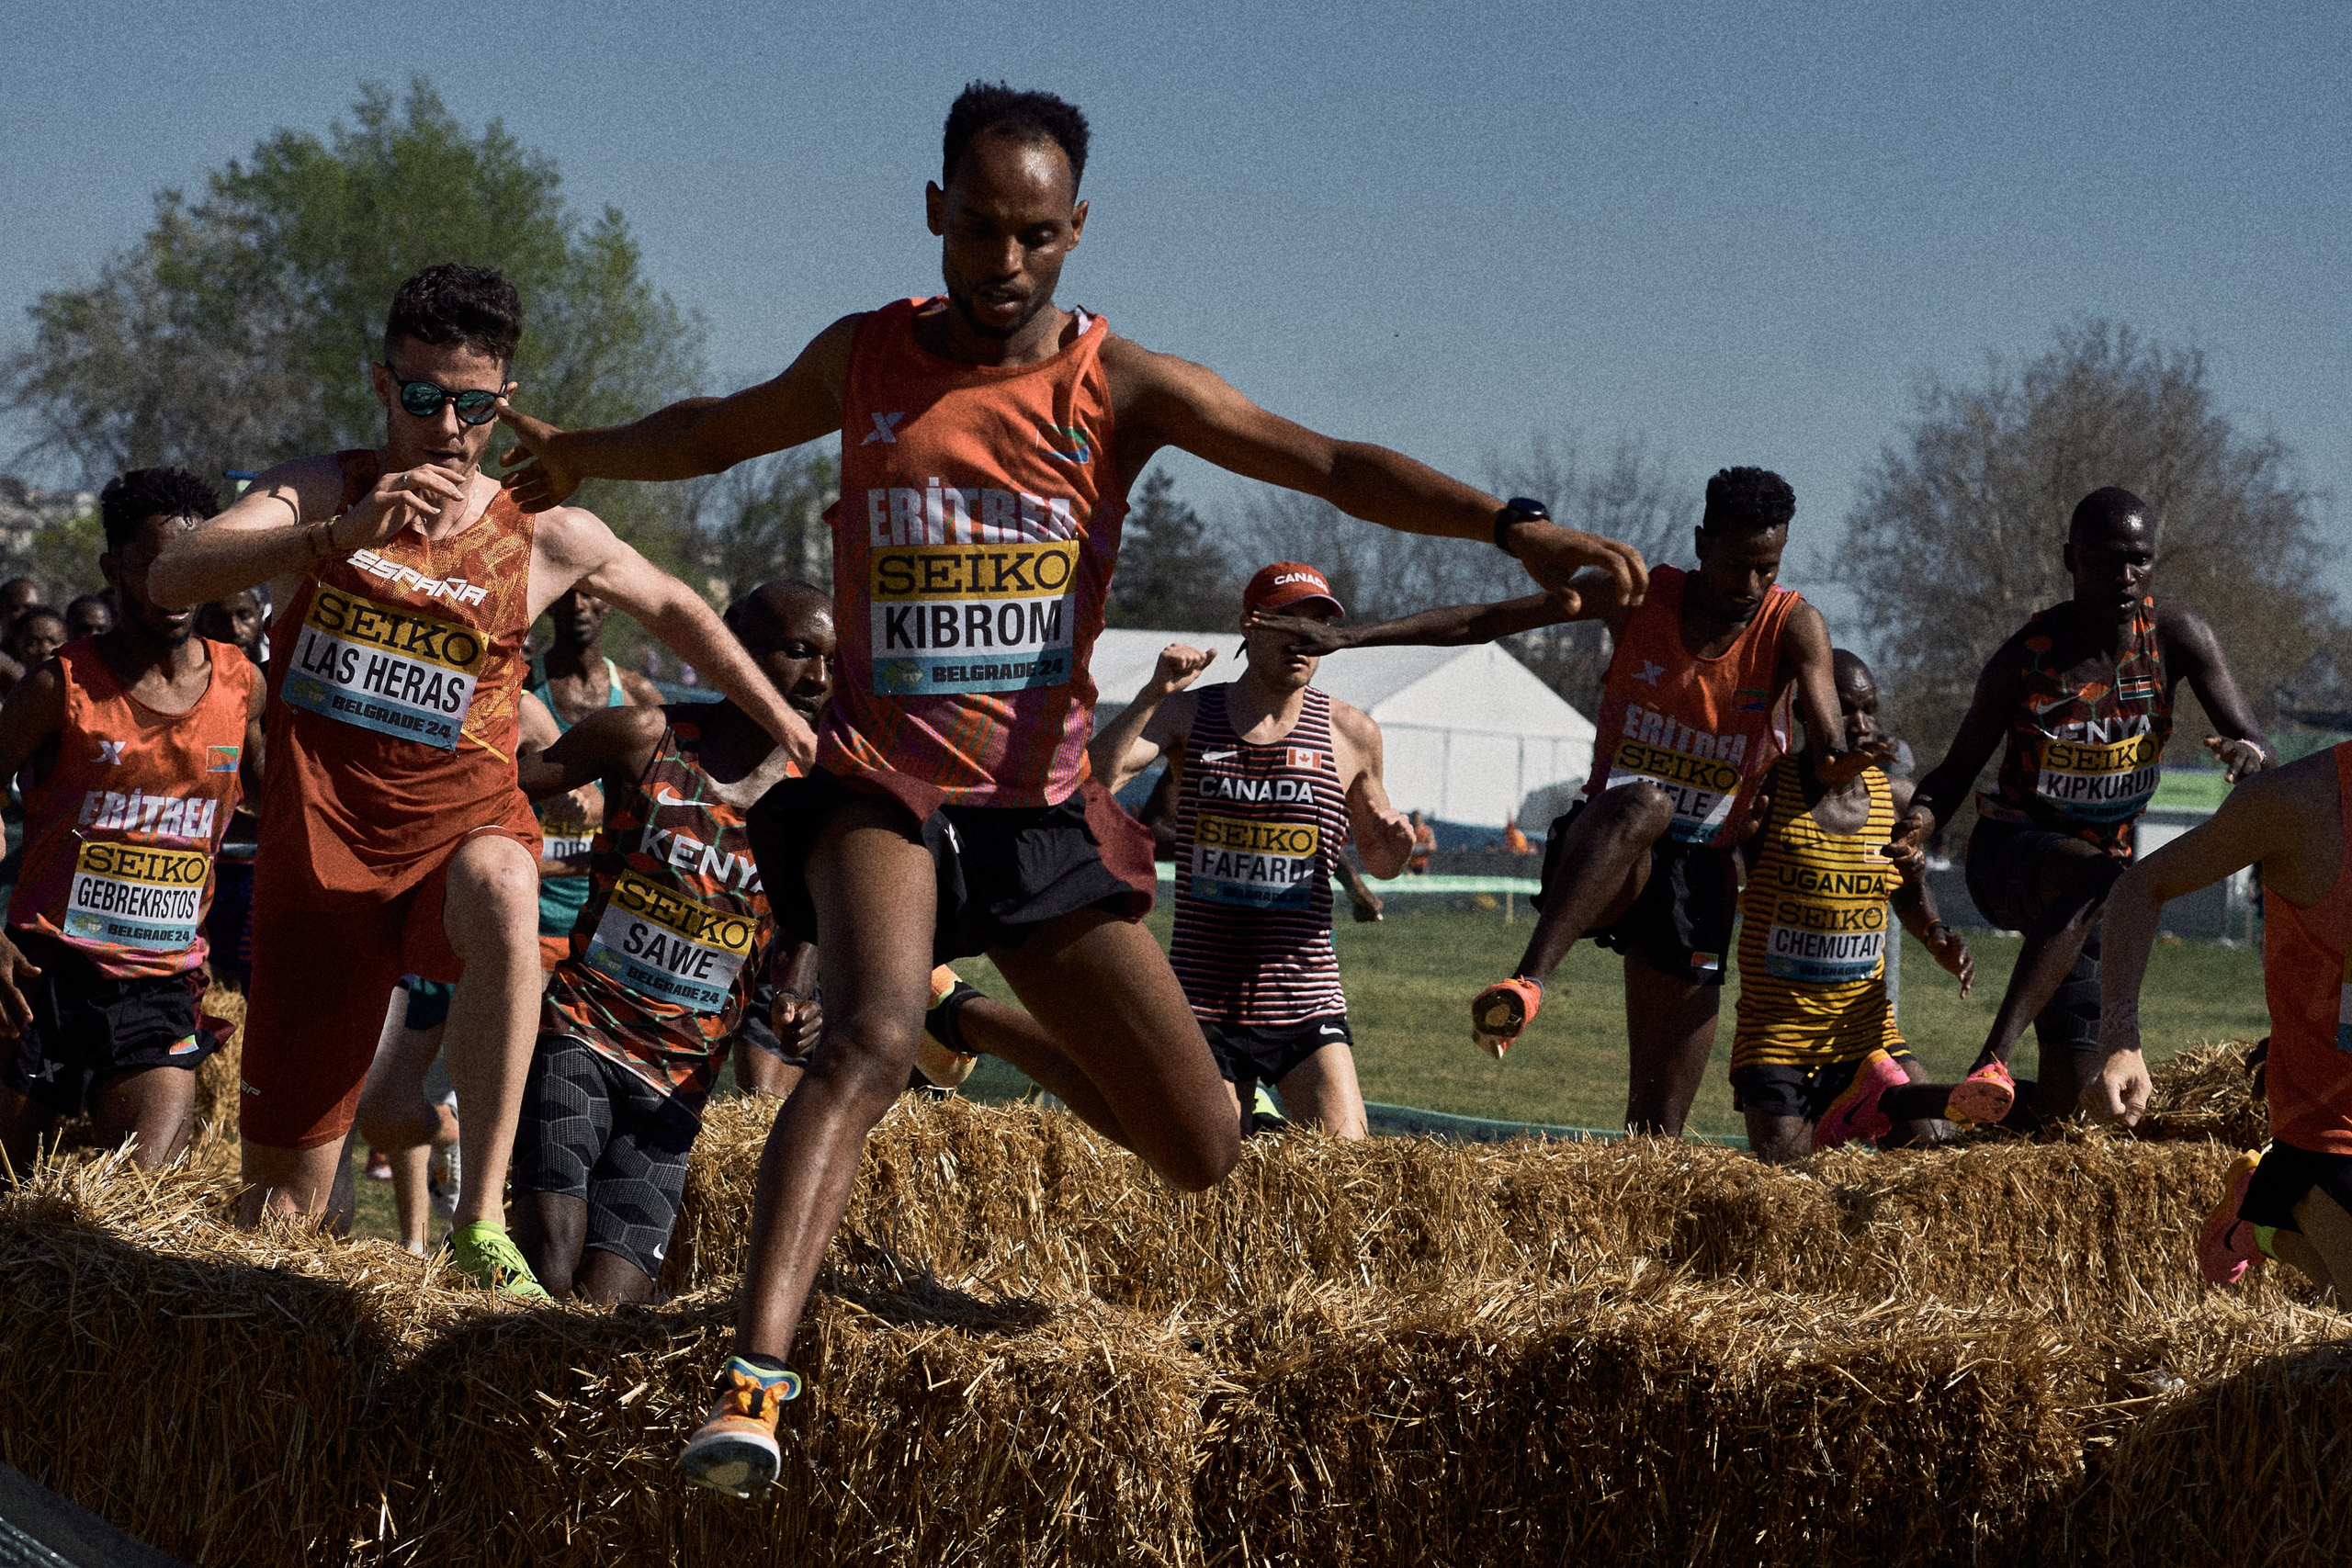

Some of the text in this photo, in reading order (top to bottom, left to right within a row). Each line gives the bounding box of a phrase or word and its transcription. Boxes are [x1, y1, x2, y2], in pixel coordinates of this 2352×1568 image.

[346, 548, 489, 606] ESPAÑA
[877, 549, 1070, 594] SEIKO
[312, 592, 479, 666] SEIKO
[885, 600, 1063, 649] KIBROM
[300, 633, 465, 713] LAS HERAS
[932, 658, 1064, 682] BELGRADE 24
[332, 694, 451, 739] BELGRADE 24
[1618, 743, 1738, 790] SEIKO
[2047, 739, 2155, 771] SEIKO
[1198, 776, 1315, 804] CANADA
[2046, 767, 2154, 799] KIPKURUI
[1199, 819, 1313, 853] SEIKO
[84, 844, 205, 884] SEIKO
[1201, 849, 1306, 884] FAFARD
[1778, 865, 1889, 895] UGANDA
[77, 877, 196, 919] GEBREKRSTOS
[617, 879, 749, 949] SEIKO
[1776, 901, 1883, 931] SEIKO
[107, 923, 190, 942] BELGRADE 24
[623, 922, 718, 979] SAWE
[1775, 929, 1880, 959] CHEMUTAI
[627, 967, 719, 1005] BELGRADE 24
